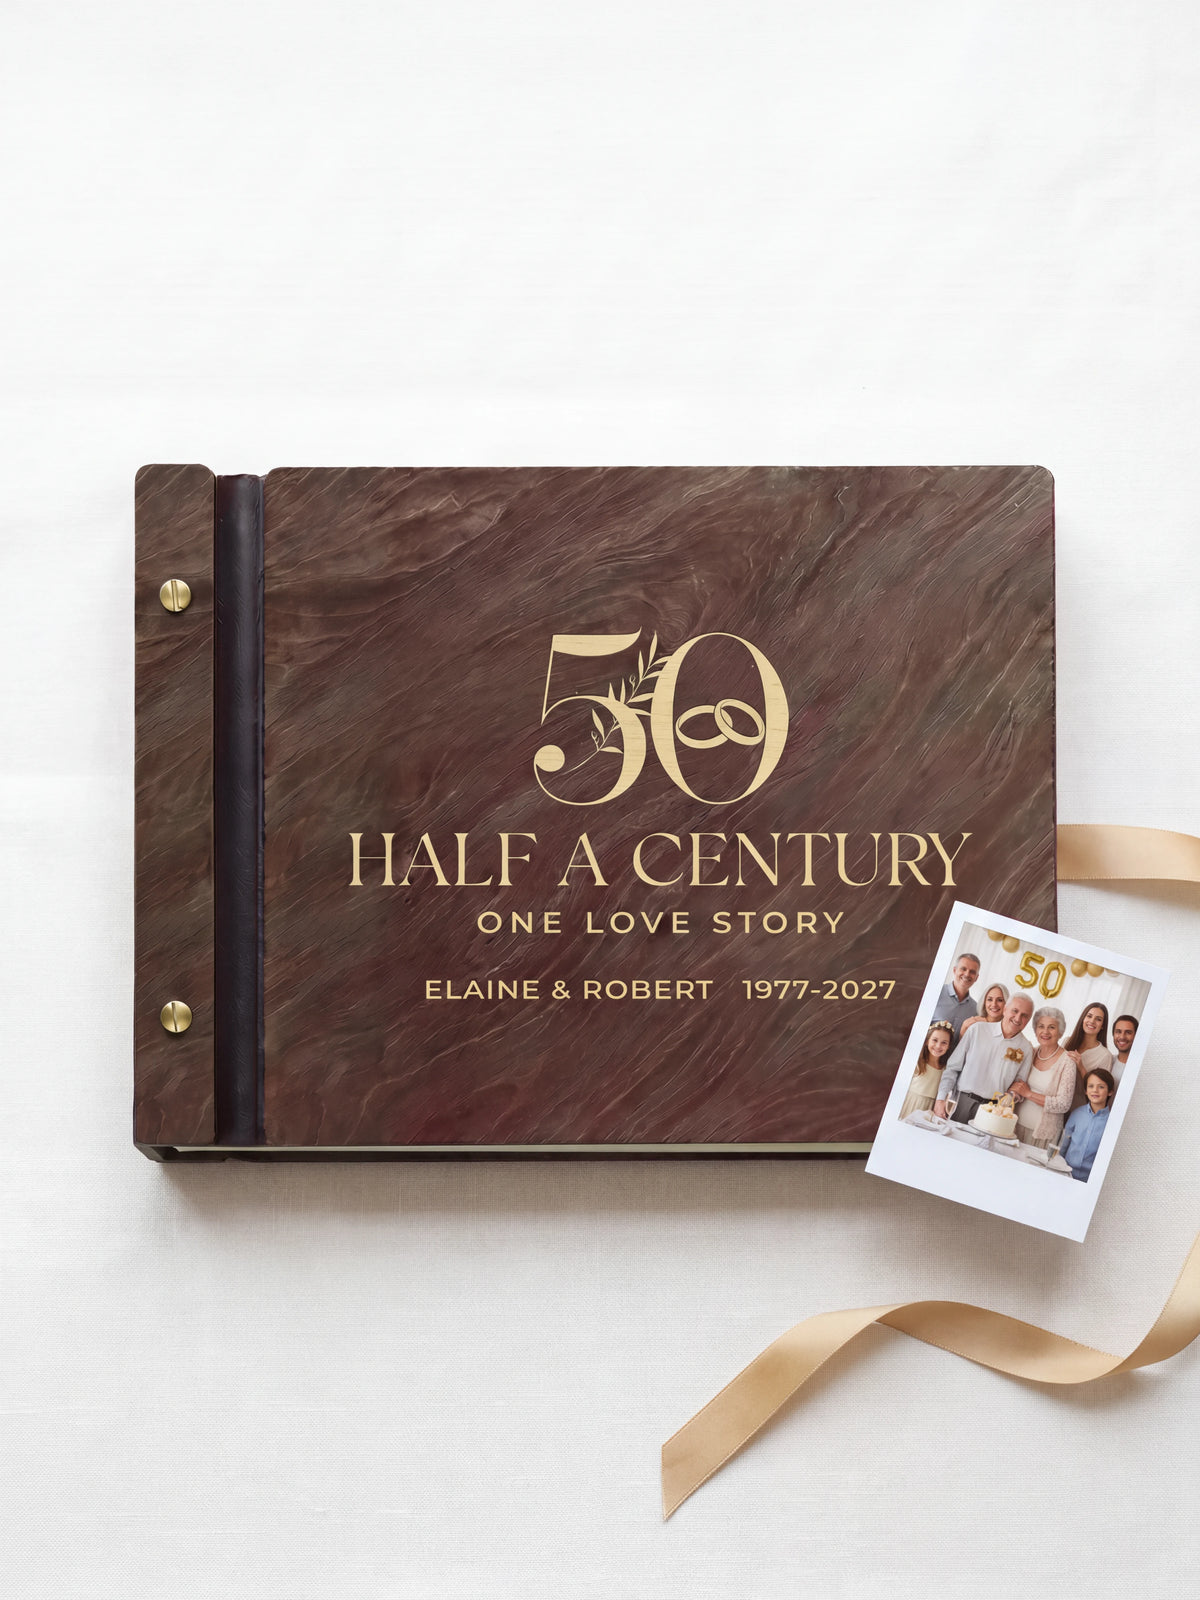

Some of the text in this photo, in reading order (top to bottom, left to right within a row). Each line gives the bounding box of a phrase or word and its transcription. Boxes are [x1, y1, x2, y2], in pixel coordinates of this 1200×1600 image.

[533, 626, 790, 806] 50
[348, 832, 973, 887] HALF A CENTURY
[477, 911, 844, 934] ONE LOVE STORY
[425, 980, 896, 1000] ELAINE & ROBERT 1977-2027
[1014, 951, 1067, 999] 50
